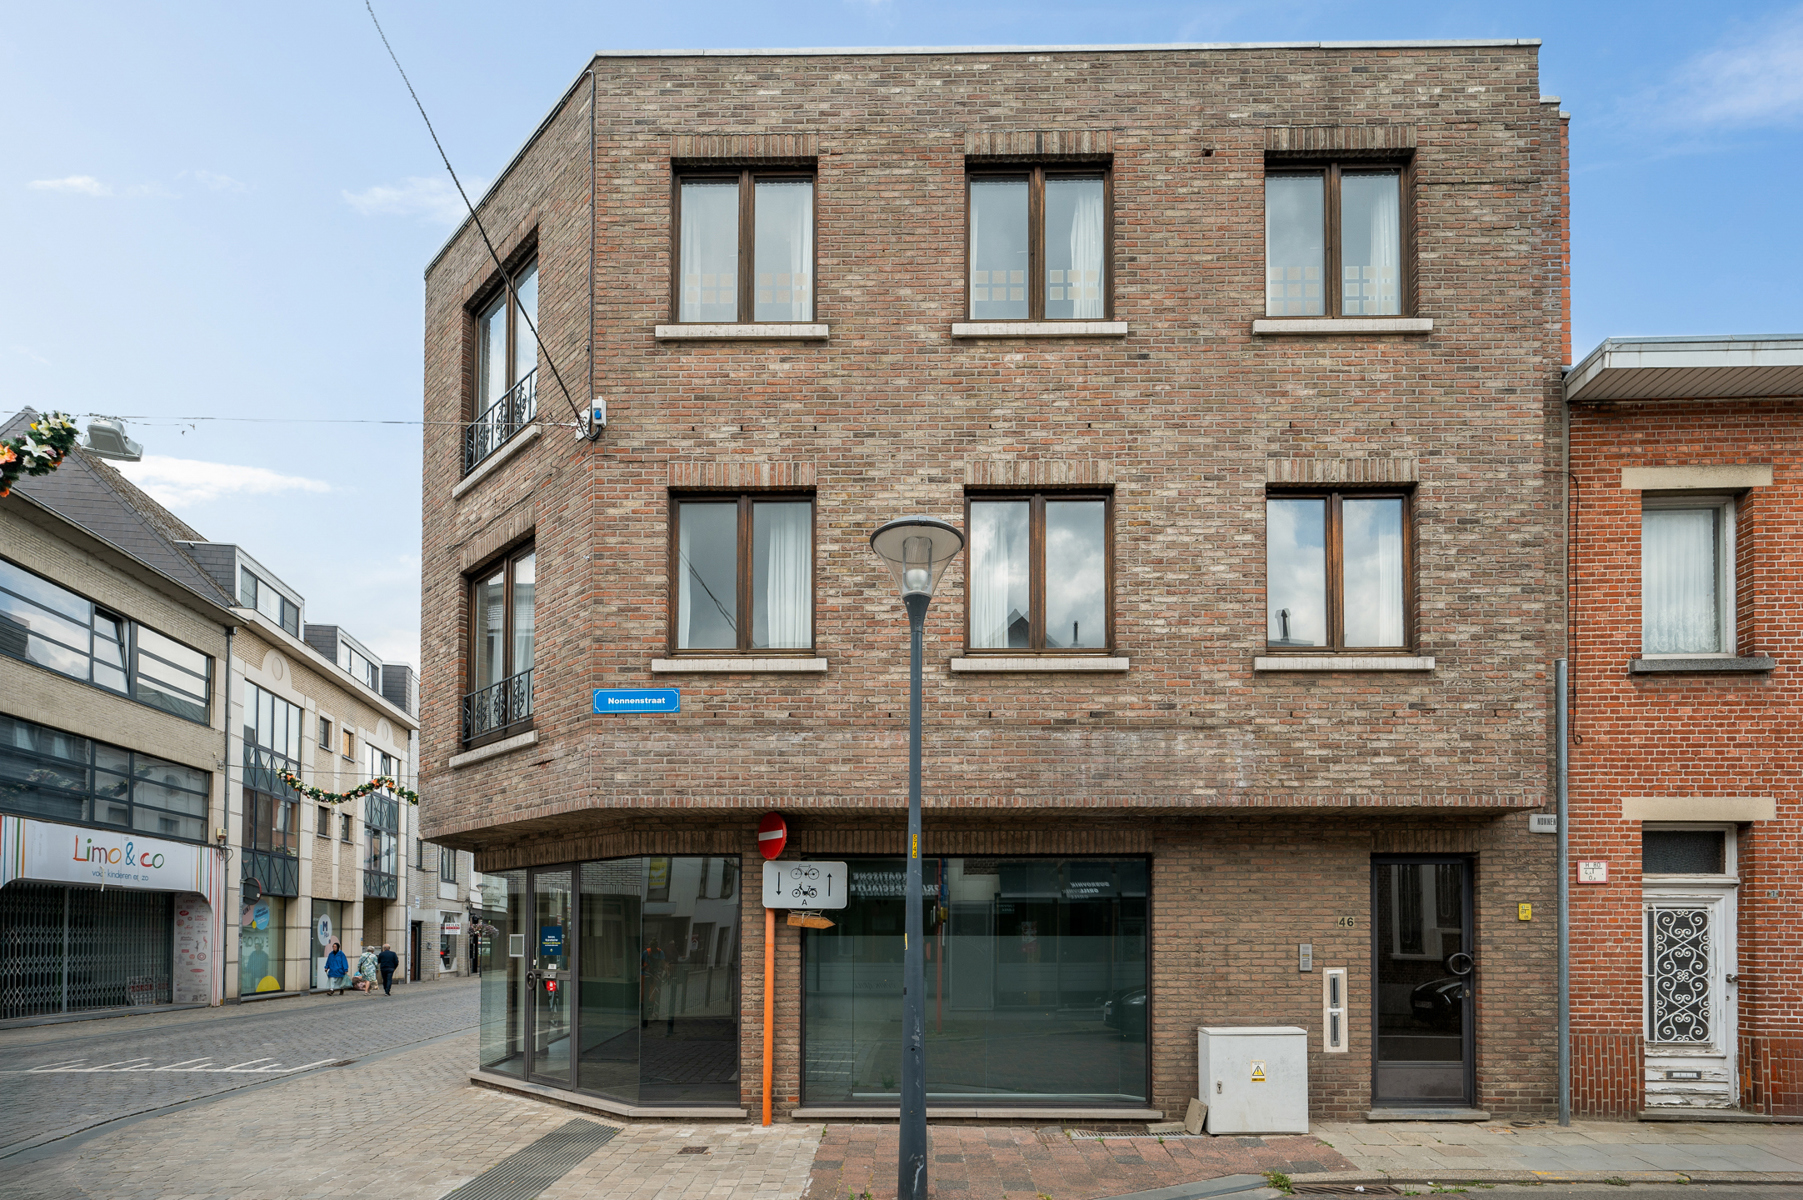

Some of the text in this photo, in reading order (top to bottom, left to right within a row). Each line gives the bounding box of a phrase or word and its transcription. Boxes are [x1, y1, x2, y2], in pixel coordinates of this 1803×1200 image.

[607, 697, 666, 705] Nonnenstraat
[72, 834, 165, 869] Limo & co
[107, 868, 132, 880] kinderen
[1338, 917, 1354, 927] 46
